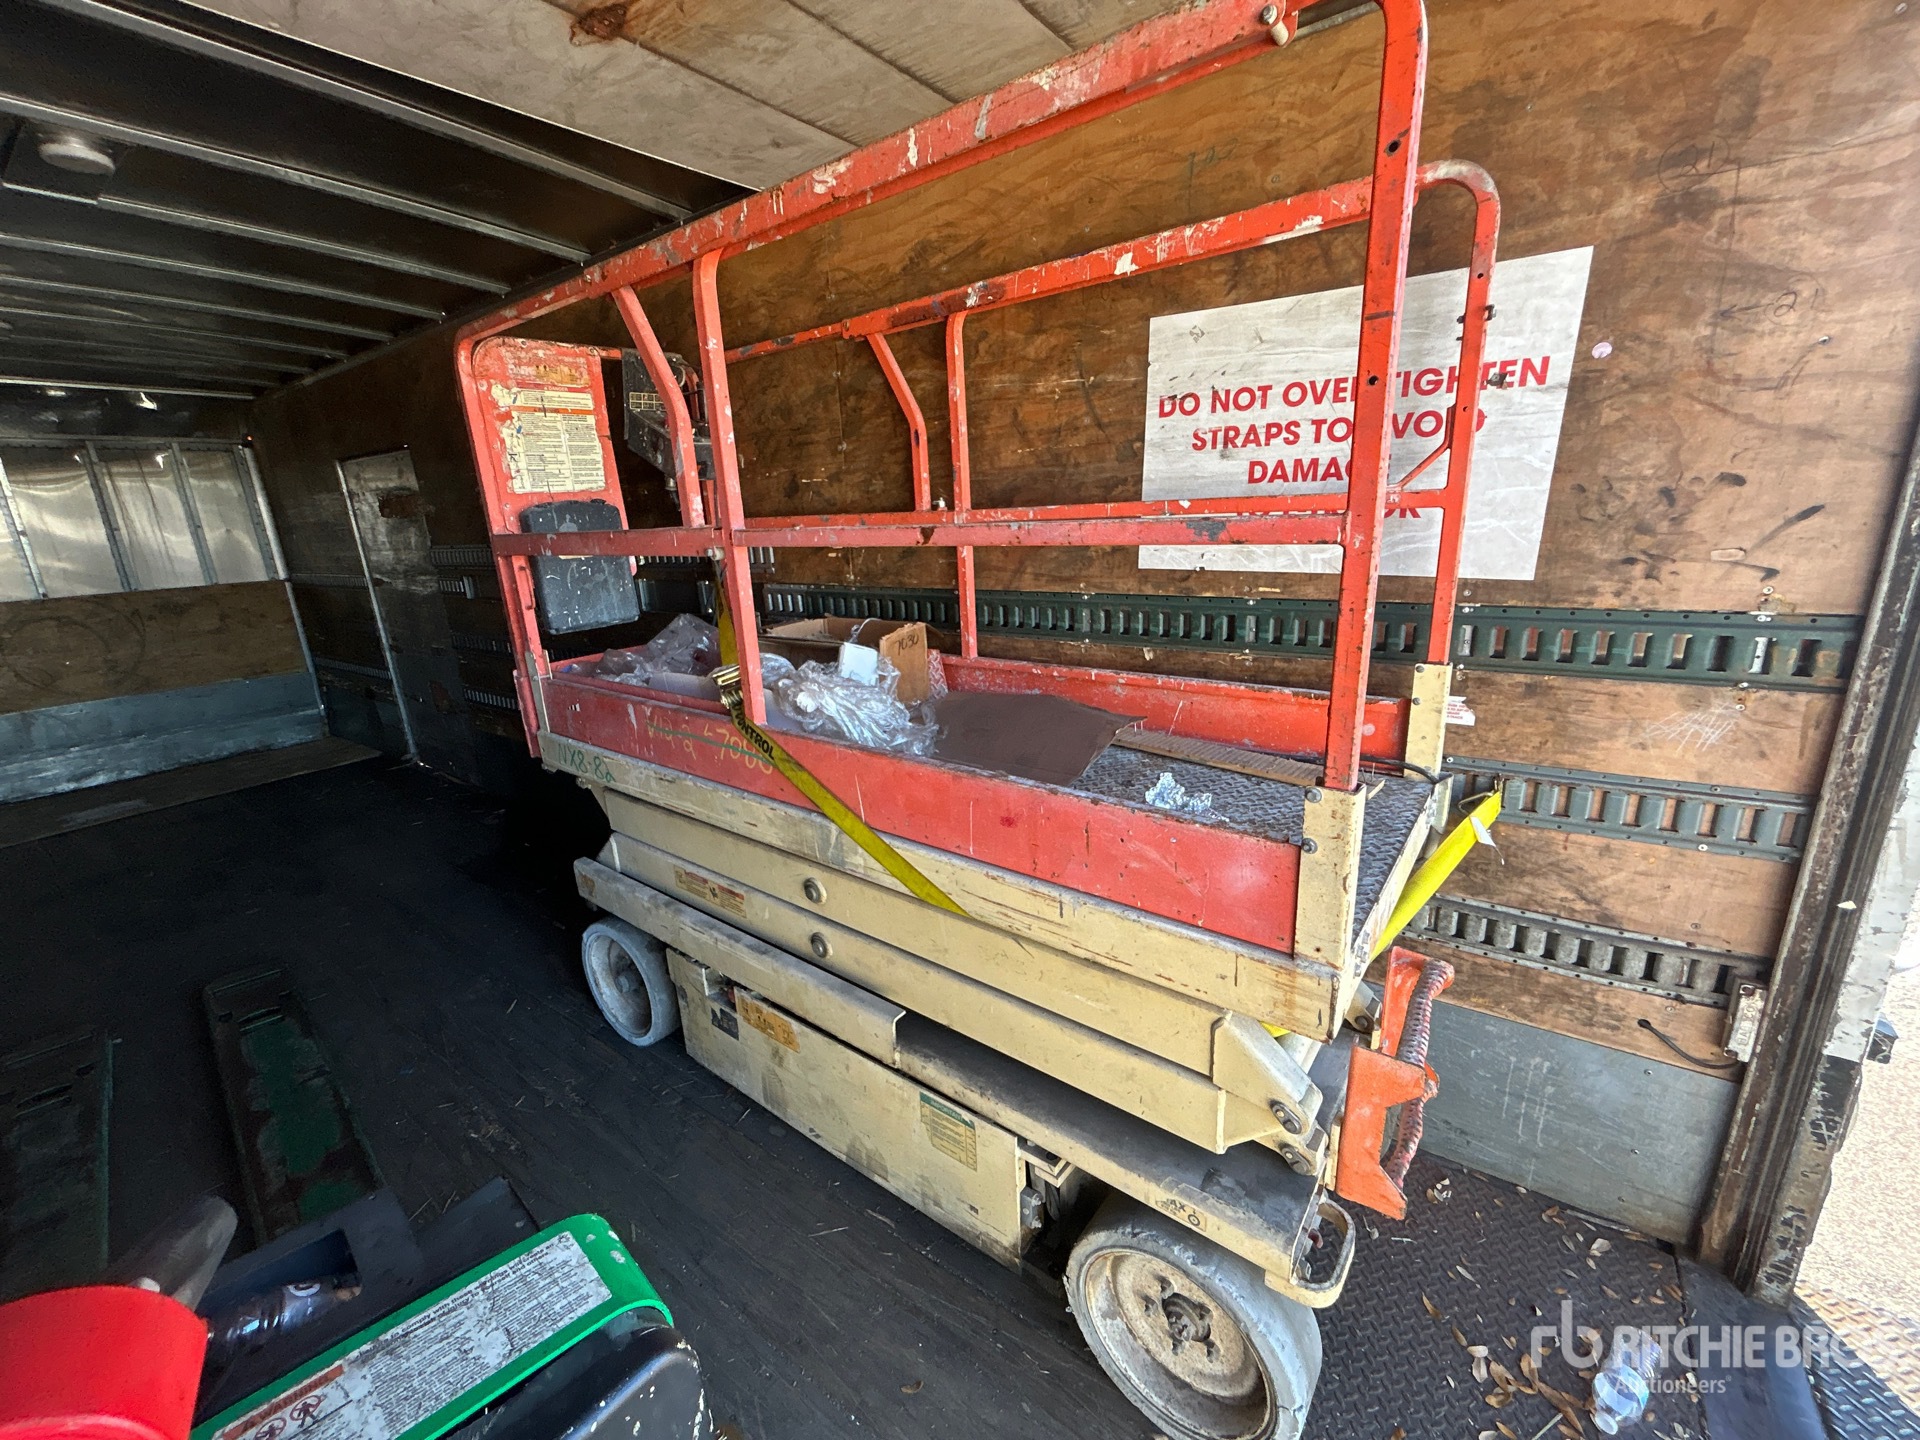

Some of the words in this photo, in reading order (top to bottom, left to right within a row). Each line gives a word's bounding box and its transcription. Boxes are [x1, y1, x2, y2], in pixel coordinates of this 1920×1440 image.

[1159, 393, 1201, 418] DO
[1211, 385, 1273, 414] NOT
[1283, 377, 1358, 407] OVE
[1396, 356, 1551, 398] IGTEN
[1192, 421, 1301, 451] STRAPS
[1311, 417, 1353, 443] TO
[1392, 409, 1486, 439] VO
[1248, 456, 1392, 485] DAMA
[511, 1264, 525, 1274] and
[400, 1313, 431, 1332] comply
[432, 1302, 450, 1314] with
[450, 1289, 472, 1304] these
